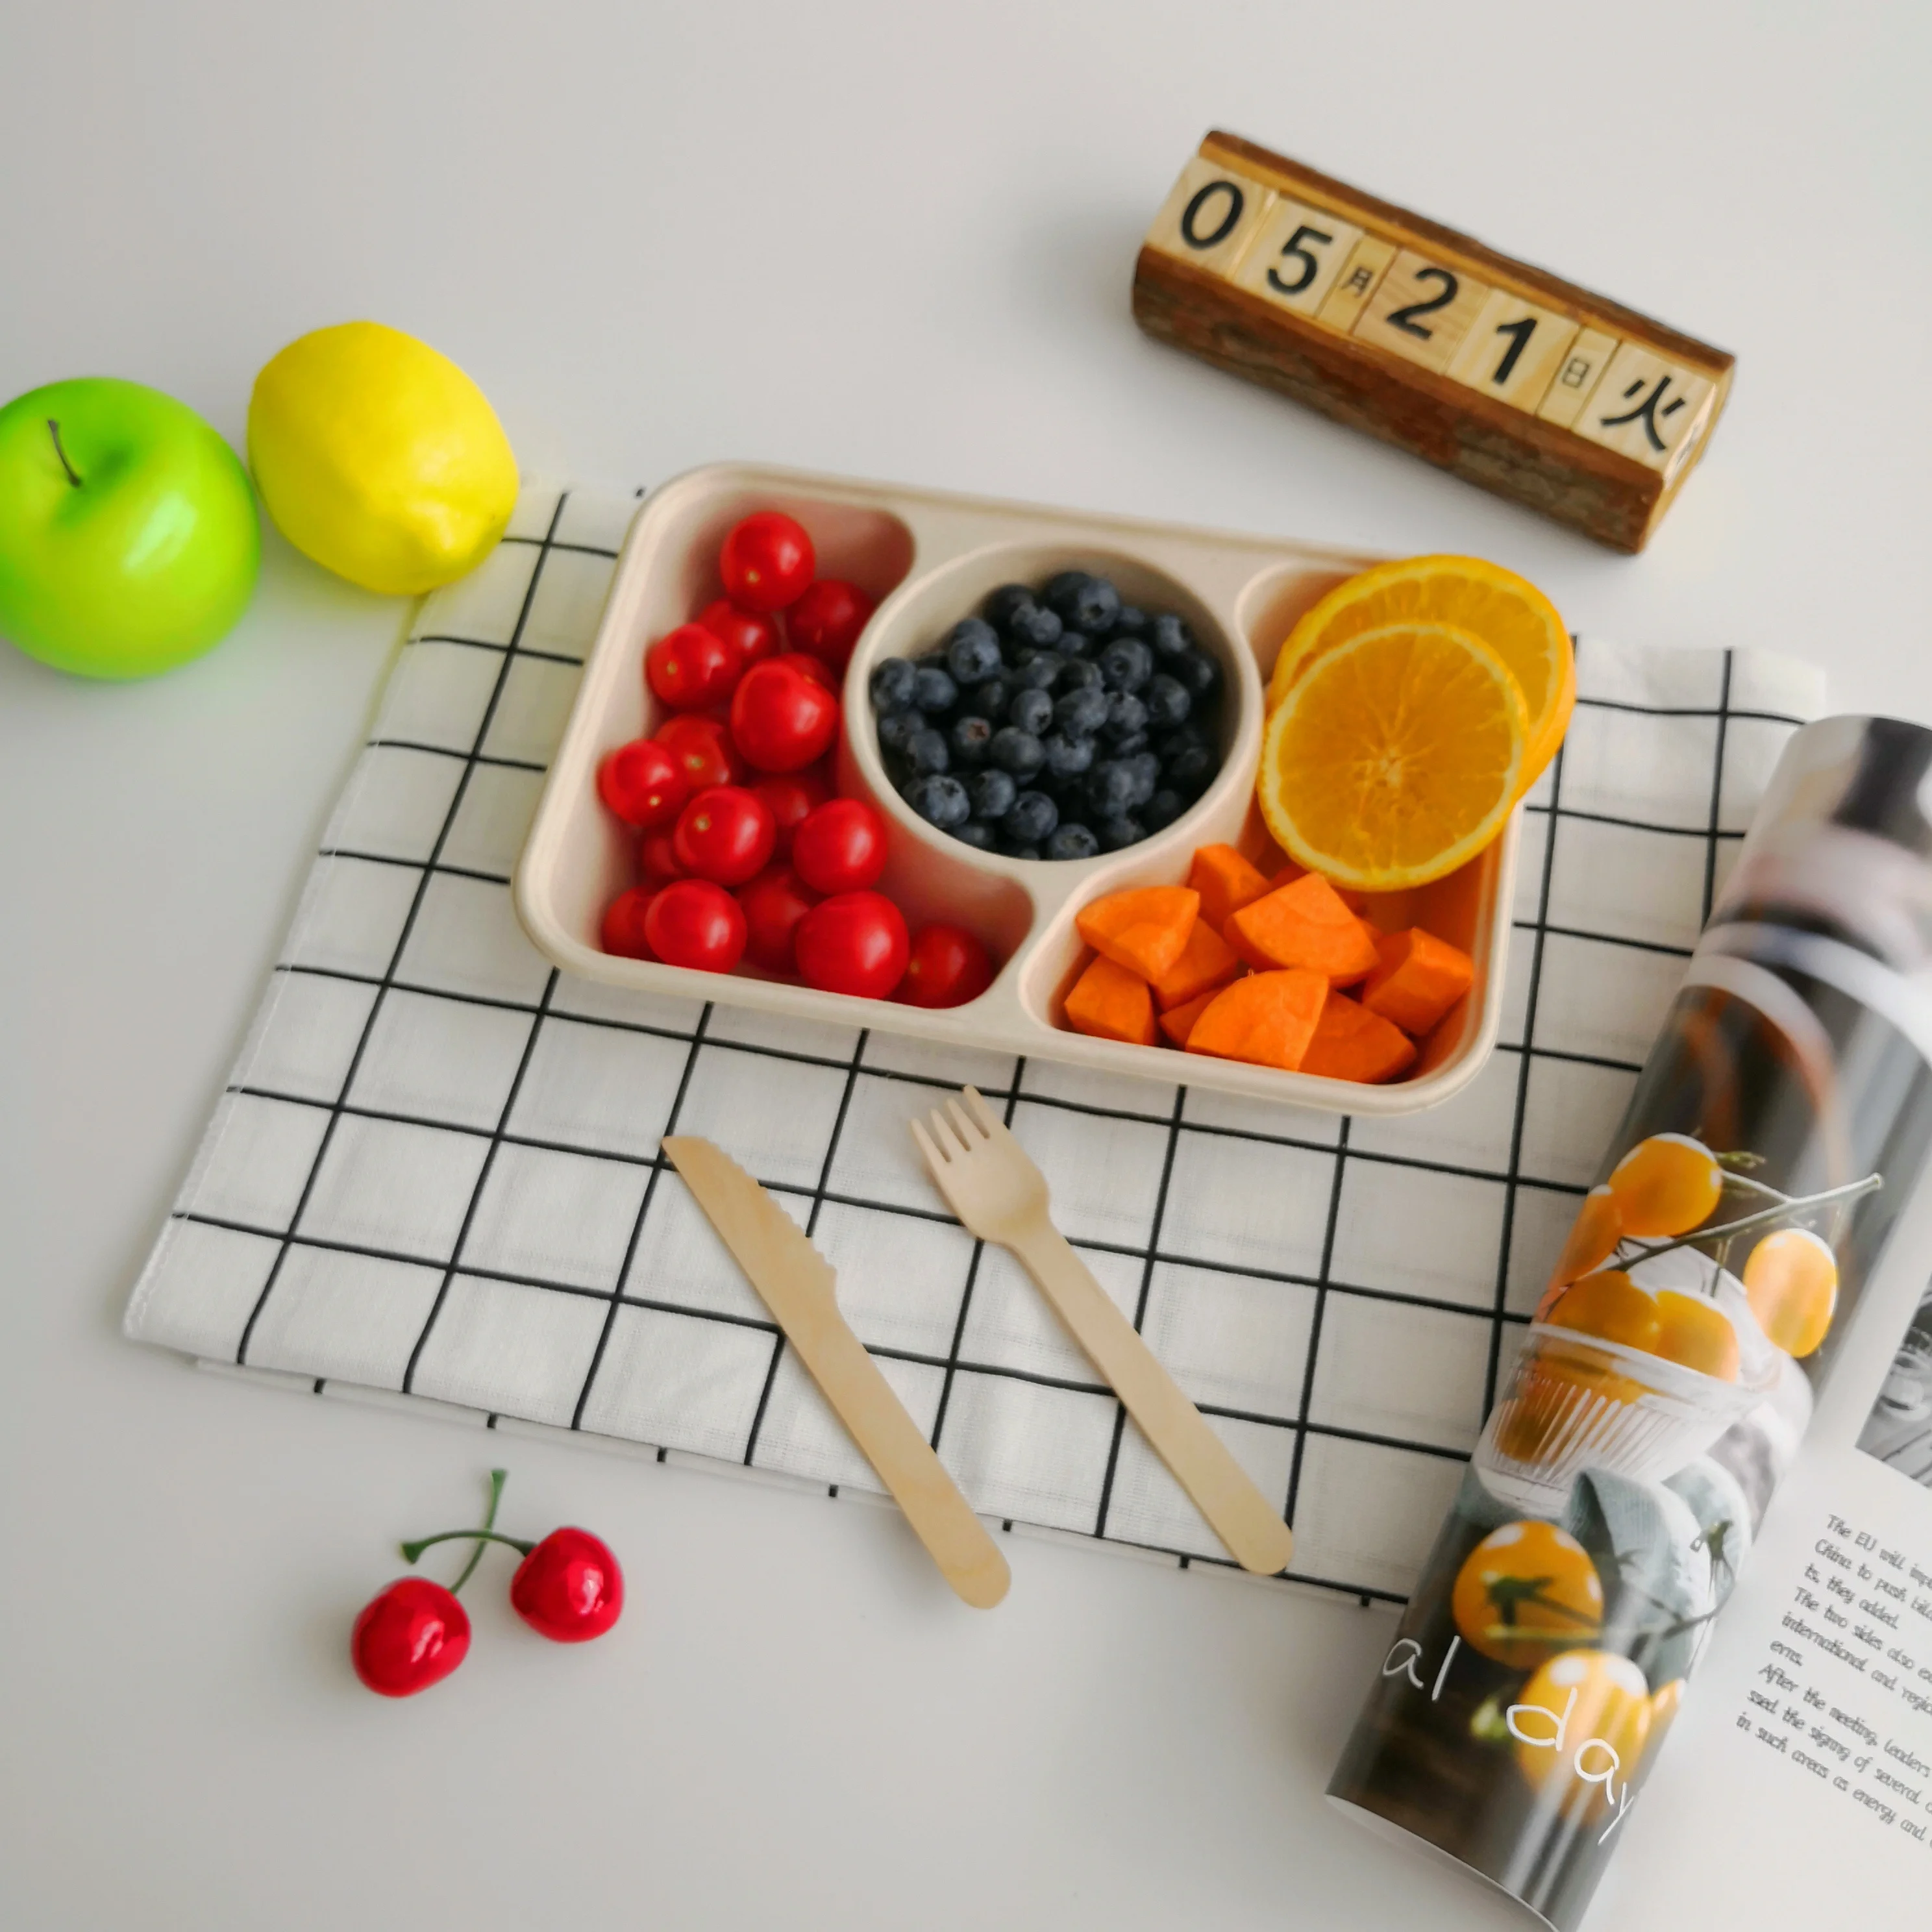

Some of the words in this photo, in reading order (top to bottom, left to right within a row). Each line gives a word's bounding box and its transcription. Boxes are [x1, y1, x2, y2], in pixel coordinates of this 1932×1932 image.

[1814, 1539, 1852, 1570] China
[1857, 1563, 1872, 1581] to
[1827, 1514, 1852, 1539] The
[1855, 1531, 1878, 1552] EU
[1879, 1548, 1906, 1571] will
[1794, 1586, 1820, 1612] The
[1824, 1604, 1848, 1629] two
[1852, 1625, 1883, 1652] sides
[1887, 1648, 1914, 1670] also
[1827, 1576, 1855, 1605] they
[1758, 1663, 1800, 1692] After
[1803, 1687, 1827, 1711] the
[1781, 1611, 1868, 1672] international
[1871, 1670, 1898, 1692] and
[1506, 1687, 1635, 1846] day
[1736, 1711, 1752, 1732] in
[1755, 1727, 1789, 1753] such
[1791, 1750, 1830, 1779] areas
[1832, 1776, 1849, 1792] as
[1852, 1789, 1897, 1826] energy
[1900, 1819, 1927, 1842] and
[1782, 1706, 1806, 1731] the
[1853, 1756, 1874, 1774] of
[1874, 1768, 1922, 1805] several
